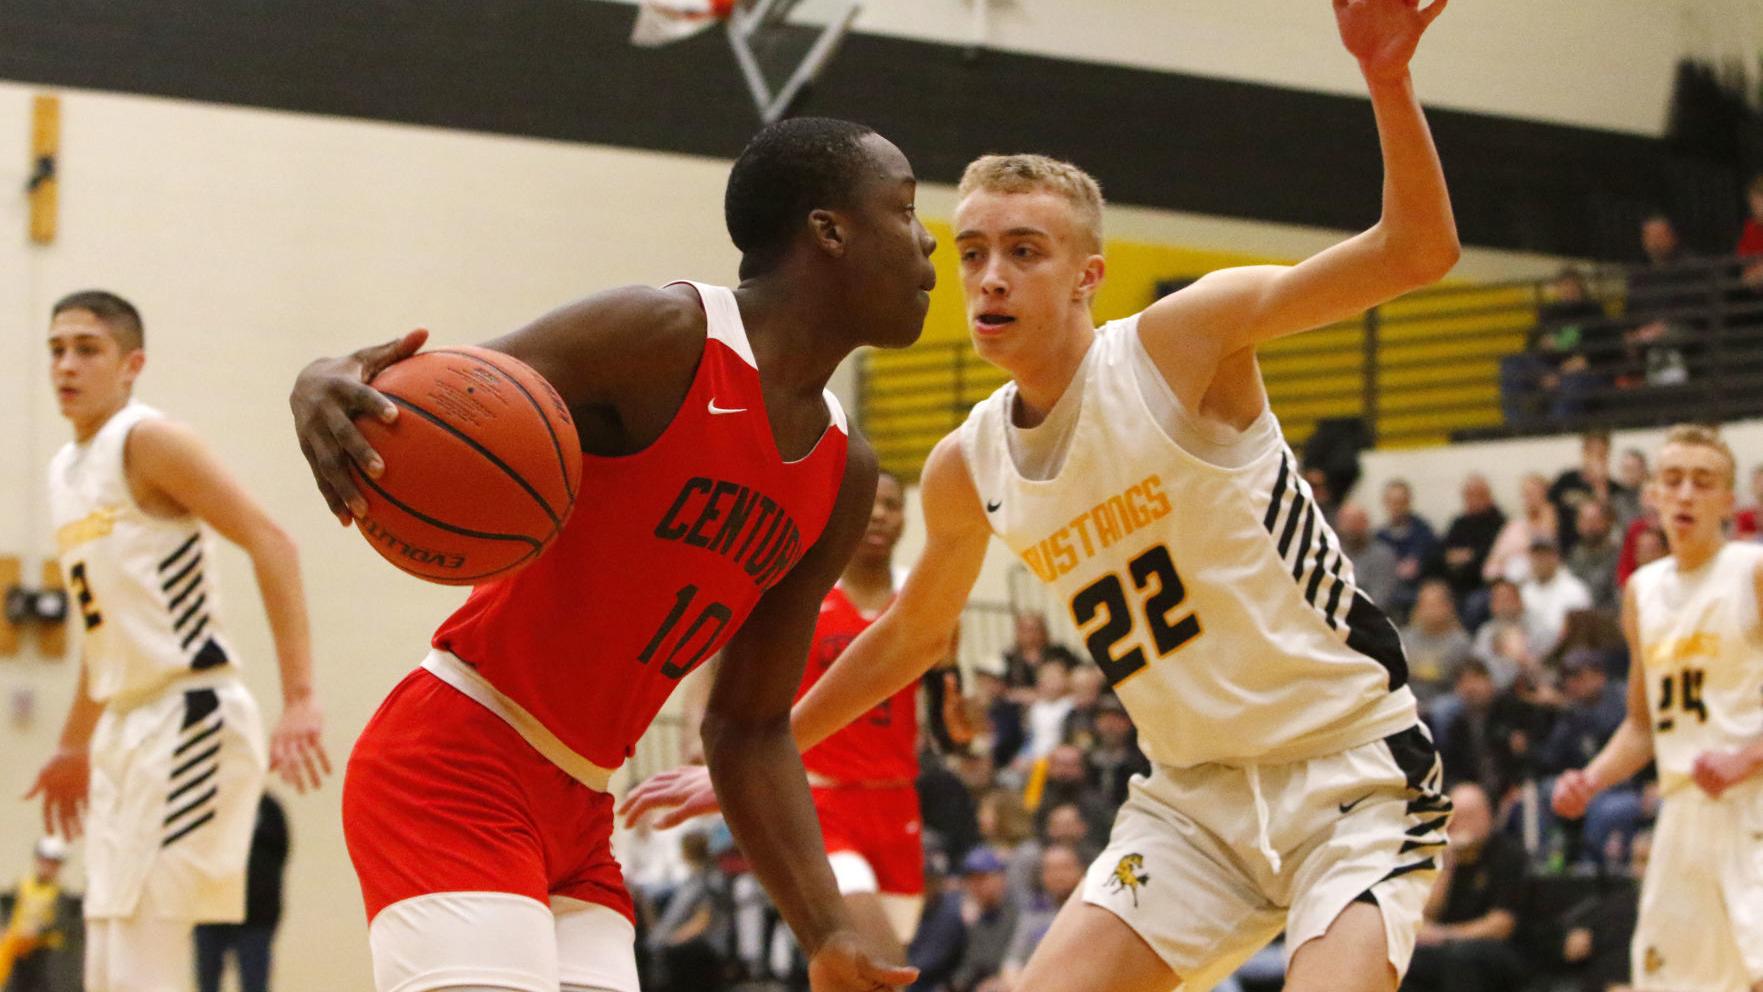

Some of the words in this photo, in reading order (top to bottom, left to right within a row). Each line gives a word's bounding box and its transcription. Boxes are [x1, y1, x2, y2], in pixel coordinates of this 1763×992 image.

[653, 476, 802, 591] CENTUR
[1022, 473, 1173, 584] USTANGS
[637, 583, 733, 680] 10
[1069, 542, 1206, 689] 22
